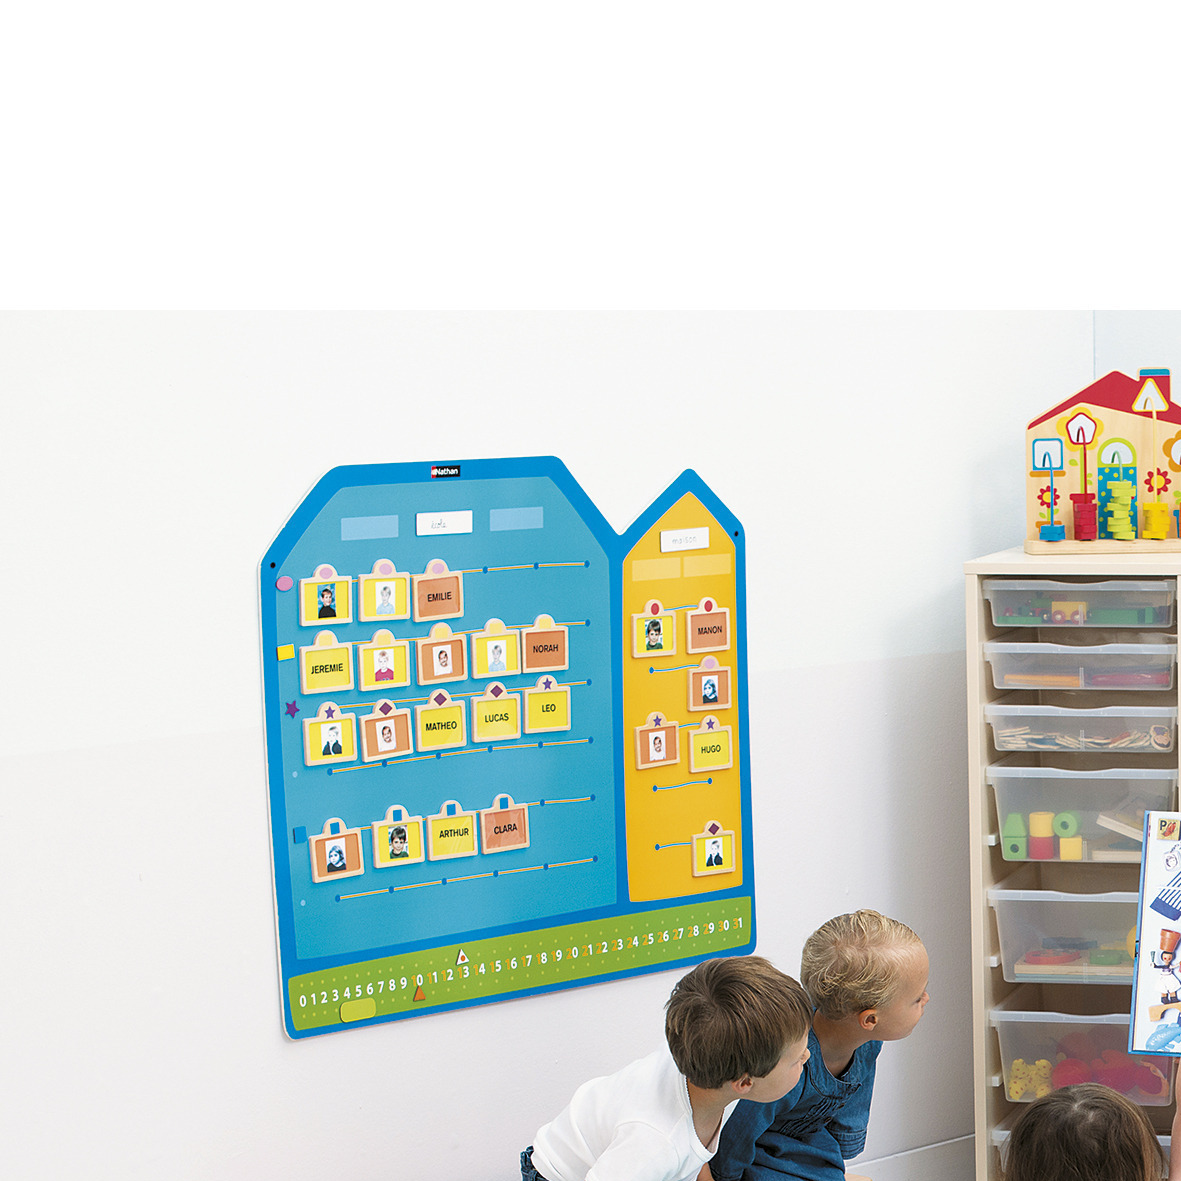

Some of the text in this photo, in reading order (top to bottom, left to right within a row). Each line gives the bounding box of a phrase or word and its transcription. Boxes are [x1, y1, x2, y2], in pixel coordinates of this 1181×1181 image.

[435, 467, 458, 476] Nathan
[426, 591, 452, 603] EMILIE
[697, 625, 723, 635] MANON
[532, 643, 559, 654] NORAH
[310, 662, 344, 675] JEREMIE
[541, 703, 557, 713] LEO
[484, 712, 510, 723] LUCAS
[425, 720, 458, 732] MATHEO
[700, 744, 722, 754] HUGO
[438, 827, 470, 839] ARTHUR
[493, 822, 518, 835] CLARA
[299, 917, 743, 1008] 0 1 2 3 4 5 6 7 8 9 10 11 12 13 14 15 16 17 18 19 20 21 22 23 24 25 26 27 28 29 30 31
